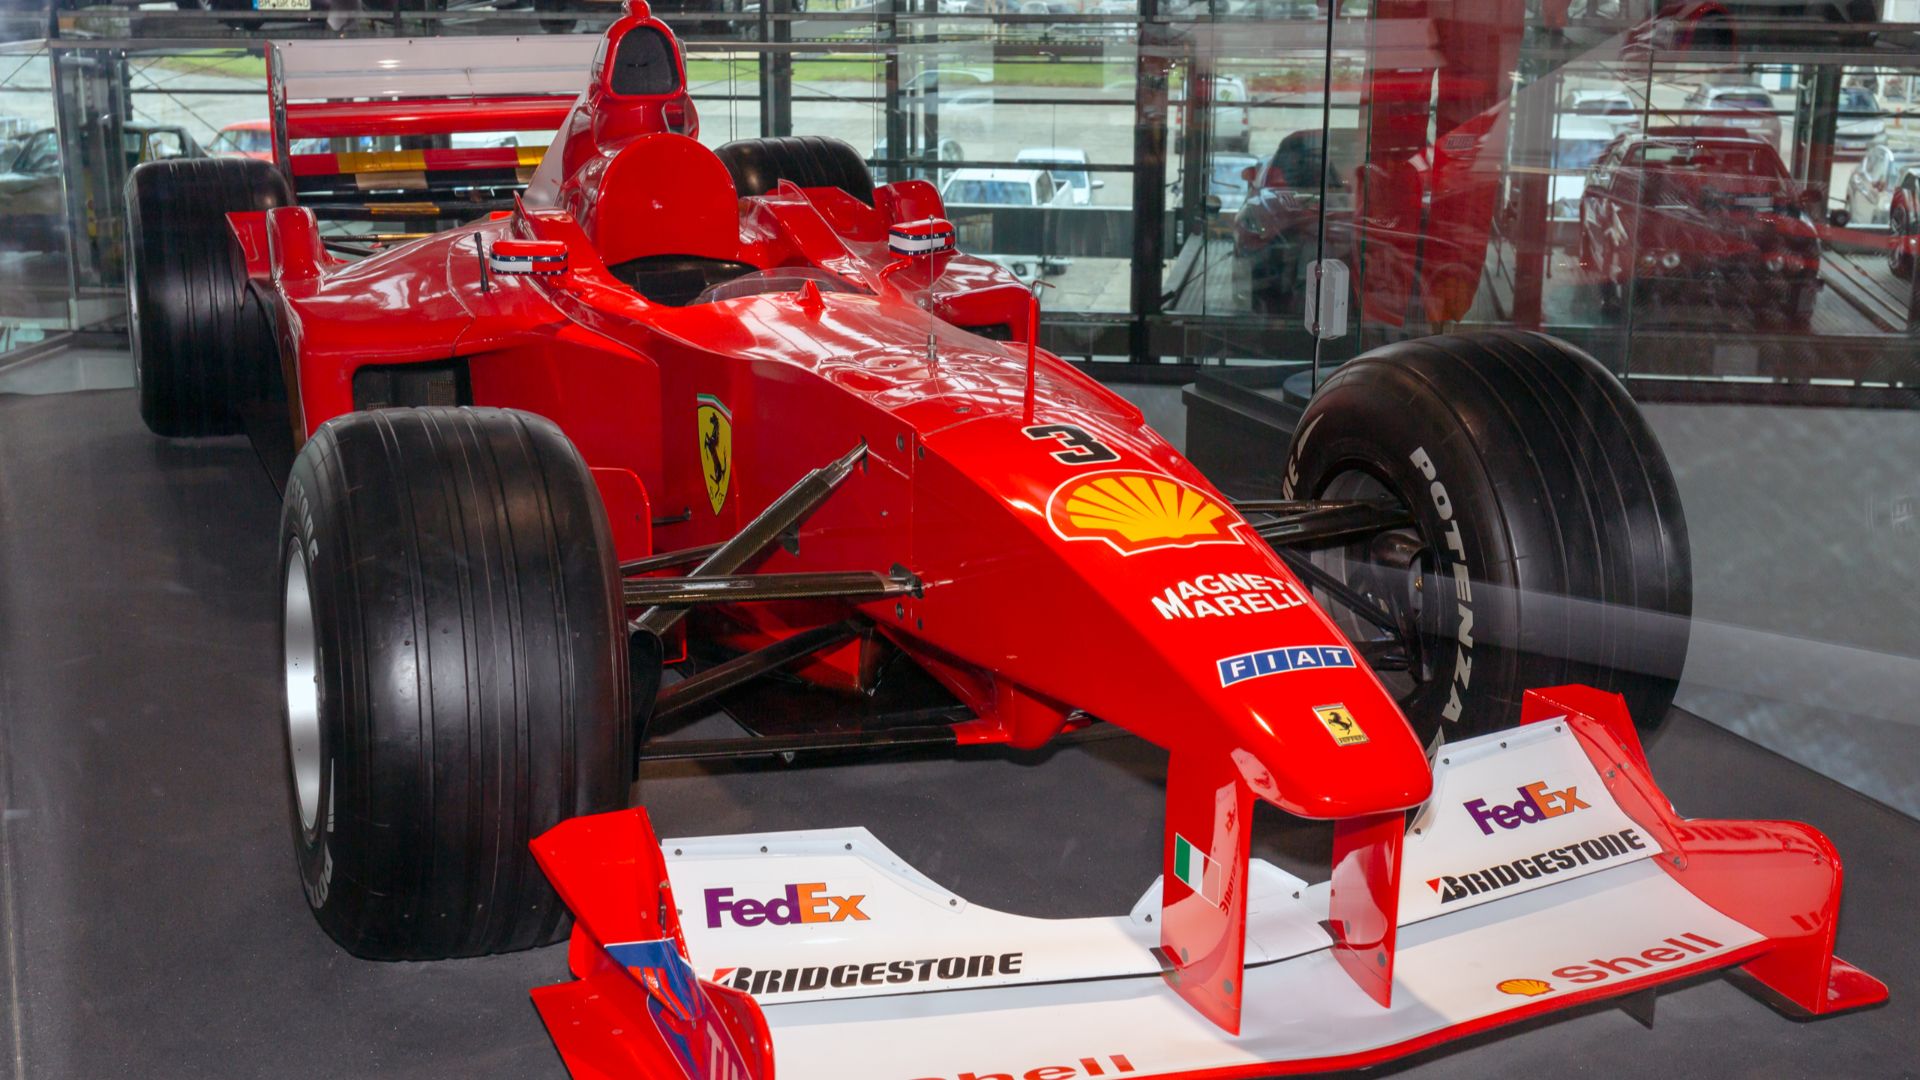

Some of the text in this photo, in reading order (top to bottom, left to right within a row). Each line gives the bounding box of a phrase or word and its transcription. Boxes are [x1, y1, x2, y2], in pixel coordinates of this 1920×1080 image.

[1022, 423, 1121, 466] 3
[1408, 446, 1474, 723] POTENZA
[1229, 648, 1344, 679] FIAT
[1463, 781, 1592, 836] FedEx
[1428, 829, 1647, 904] BRIDGESTONE
[704, 882, 871, 928] FedEx
[713, 952, 1023, 995] BRIDGESTONE
[1551, 931, 1723, 984] Shell
